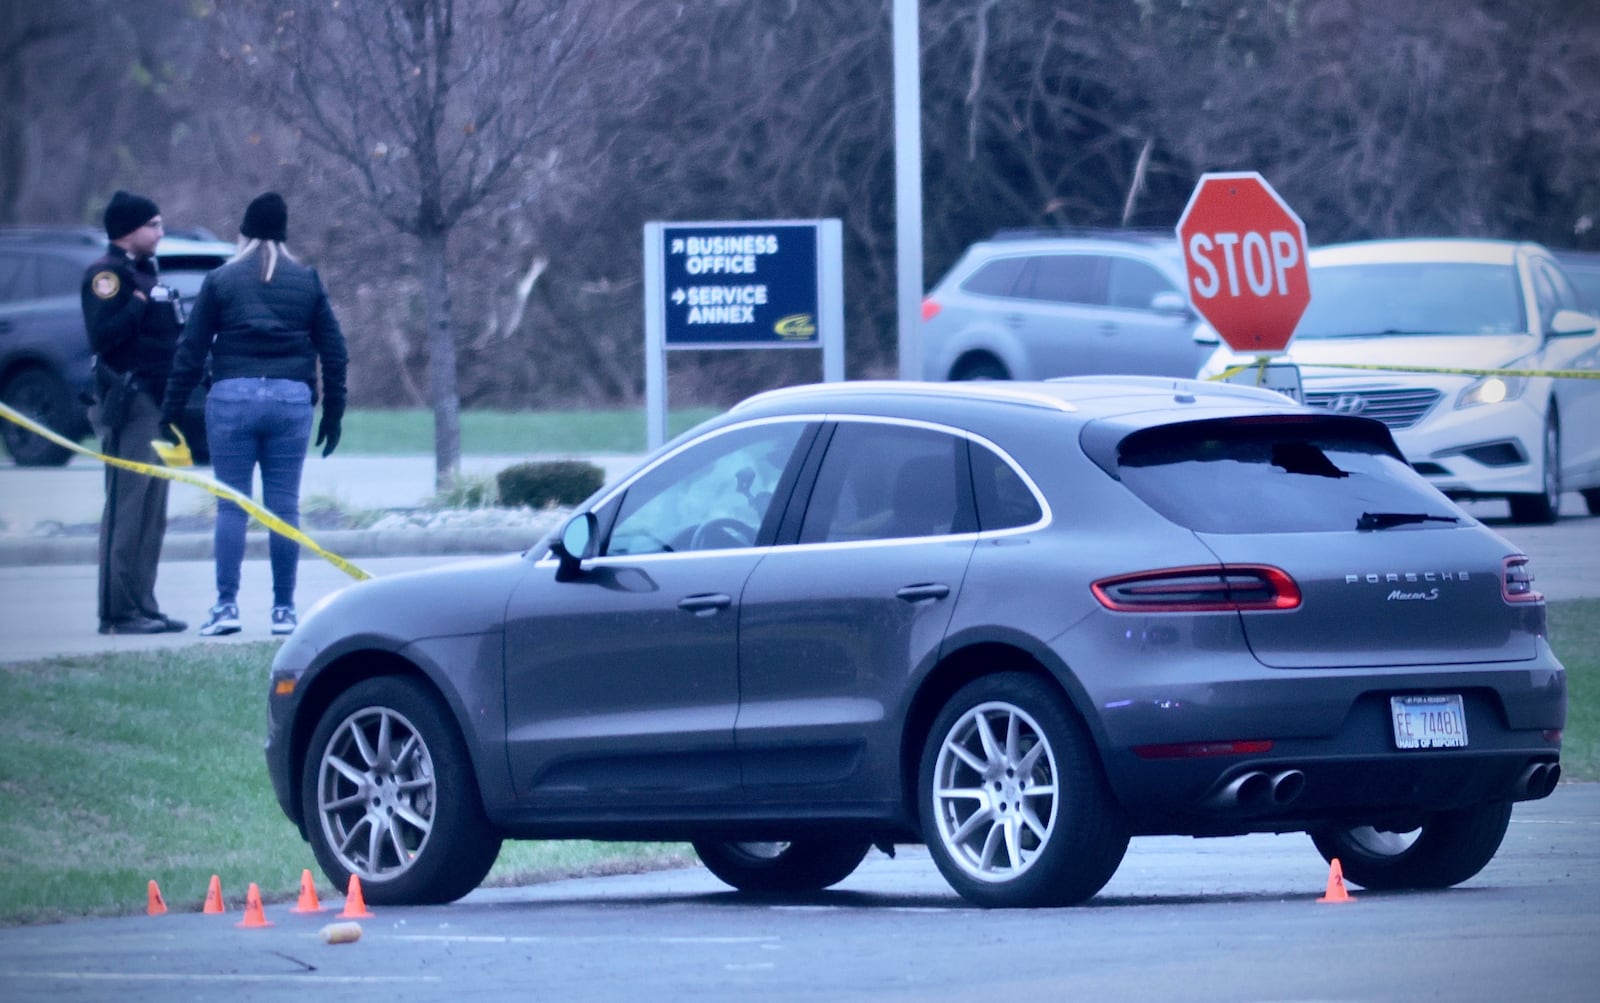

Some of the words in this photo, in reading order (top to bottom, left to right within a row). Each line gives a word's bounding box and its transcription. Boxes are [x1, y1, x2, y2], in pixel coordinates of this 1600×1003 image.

[687, 235, 778, 255] BUSINESS
[686, 255, 756, 274] OFFICE
[1189, 231, 1299, 298] STOP
[688, 285, 767, 305] SERVICE
[688, 305, 755, 324] ANNEX
[1345, 571, 1470, 584] PORSCHE
[1387, 590, 1425, 601] Macan
[1425, 588, 1440, 601] S
[1420, 711, 1461, 735] 74481
